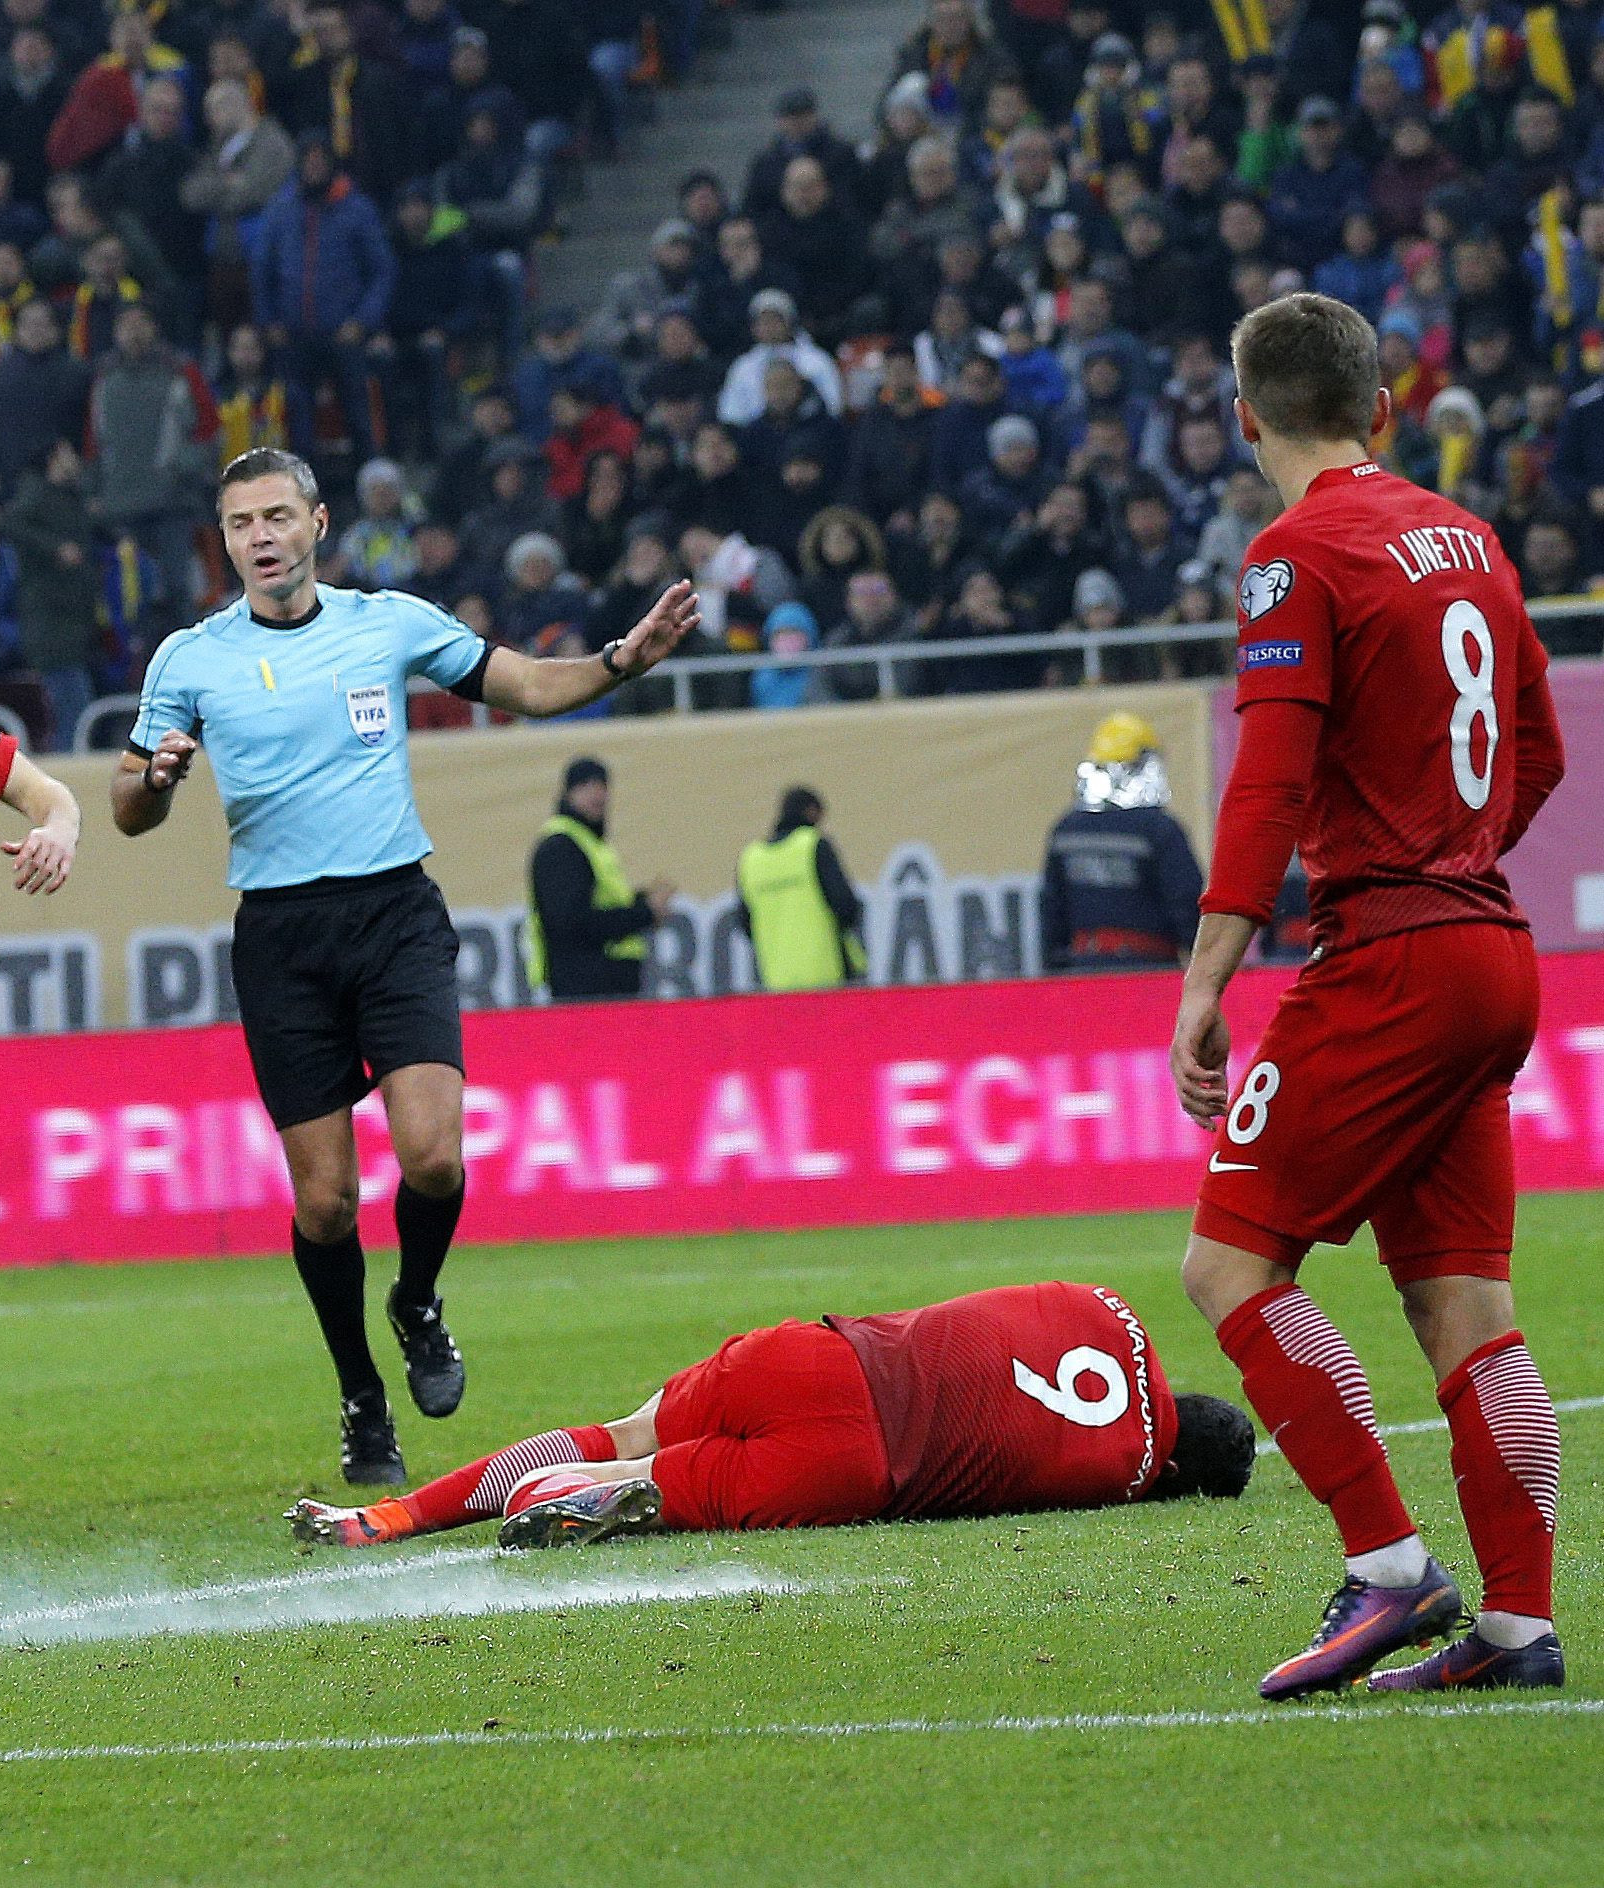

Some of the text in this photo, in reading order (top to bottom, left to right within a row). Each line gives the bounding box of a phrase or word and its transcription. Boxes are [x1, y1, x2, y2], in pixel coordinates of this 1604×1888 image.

[1385, 526, 1490, 583] LINETTY
[1248, 646, 1301, 662] RESPECT
[355, 706, 385, 722] FIFA
[1441, 599, 1497, 810] 8
[1227, 1061, 1281, 1145] 8
[36, 1078, 666, 1222] PRINCPAL
[696, 1068, 848, 1184] AL
[1012, 1345, 1130, 1427] 9
